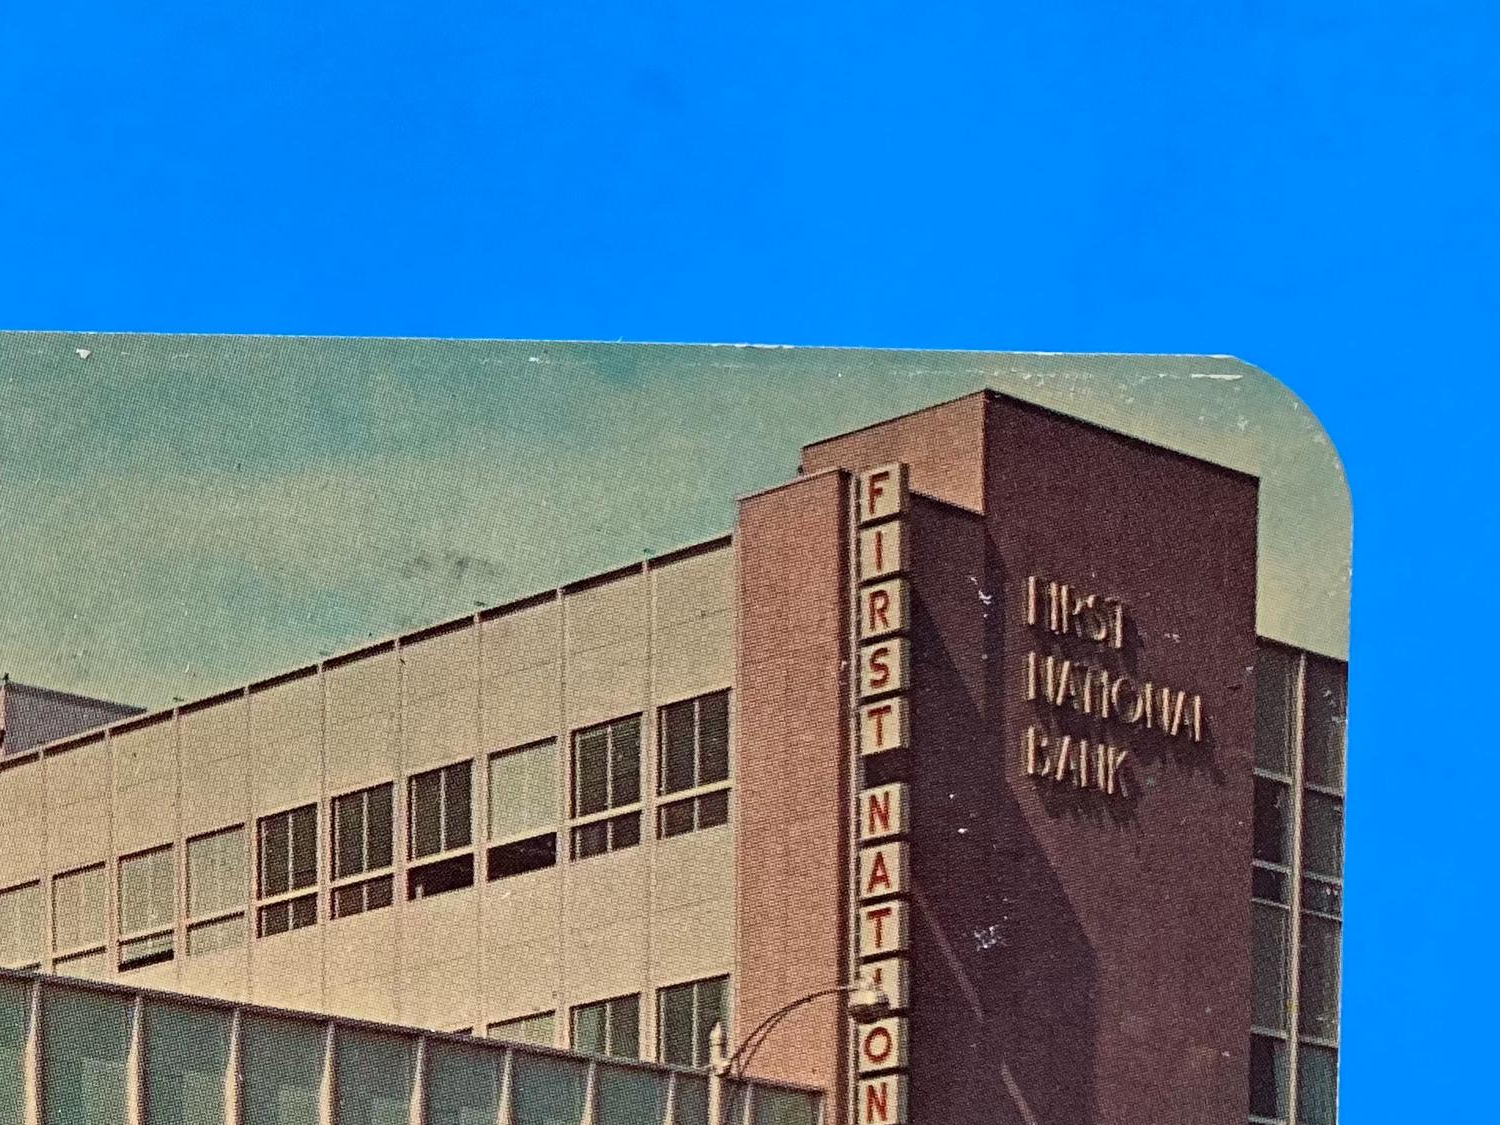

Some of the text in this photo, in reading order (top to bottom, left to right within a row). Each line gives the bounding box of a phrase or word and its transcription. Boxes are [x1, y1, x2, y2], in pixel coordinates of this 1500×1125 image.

[866, 469, 892, 748] FIRST
[1026, 574, 1126, 650] FIRST
[1026, 650, 1204, 743] NATIONAL
[1025, 725, 1130, 798] BANK
